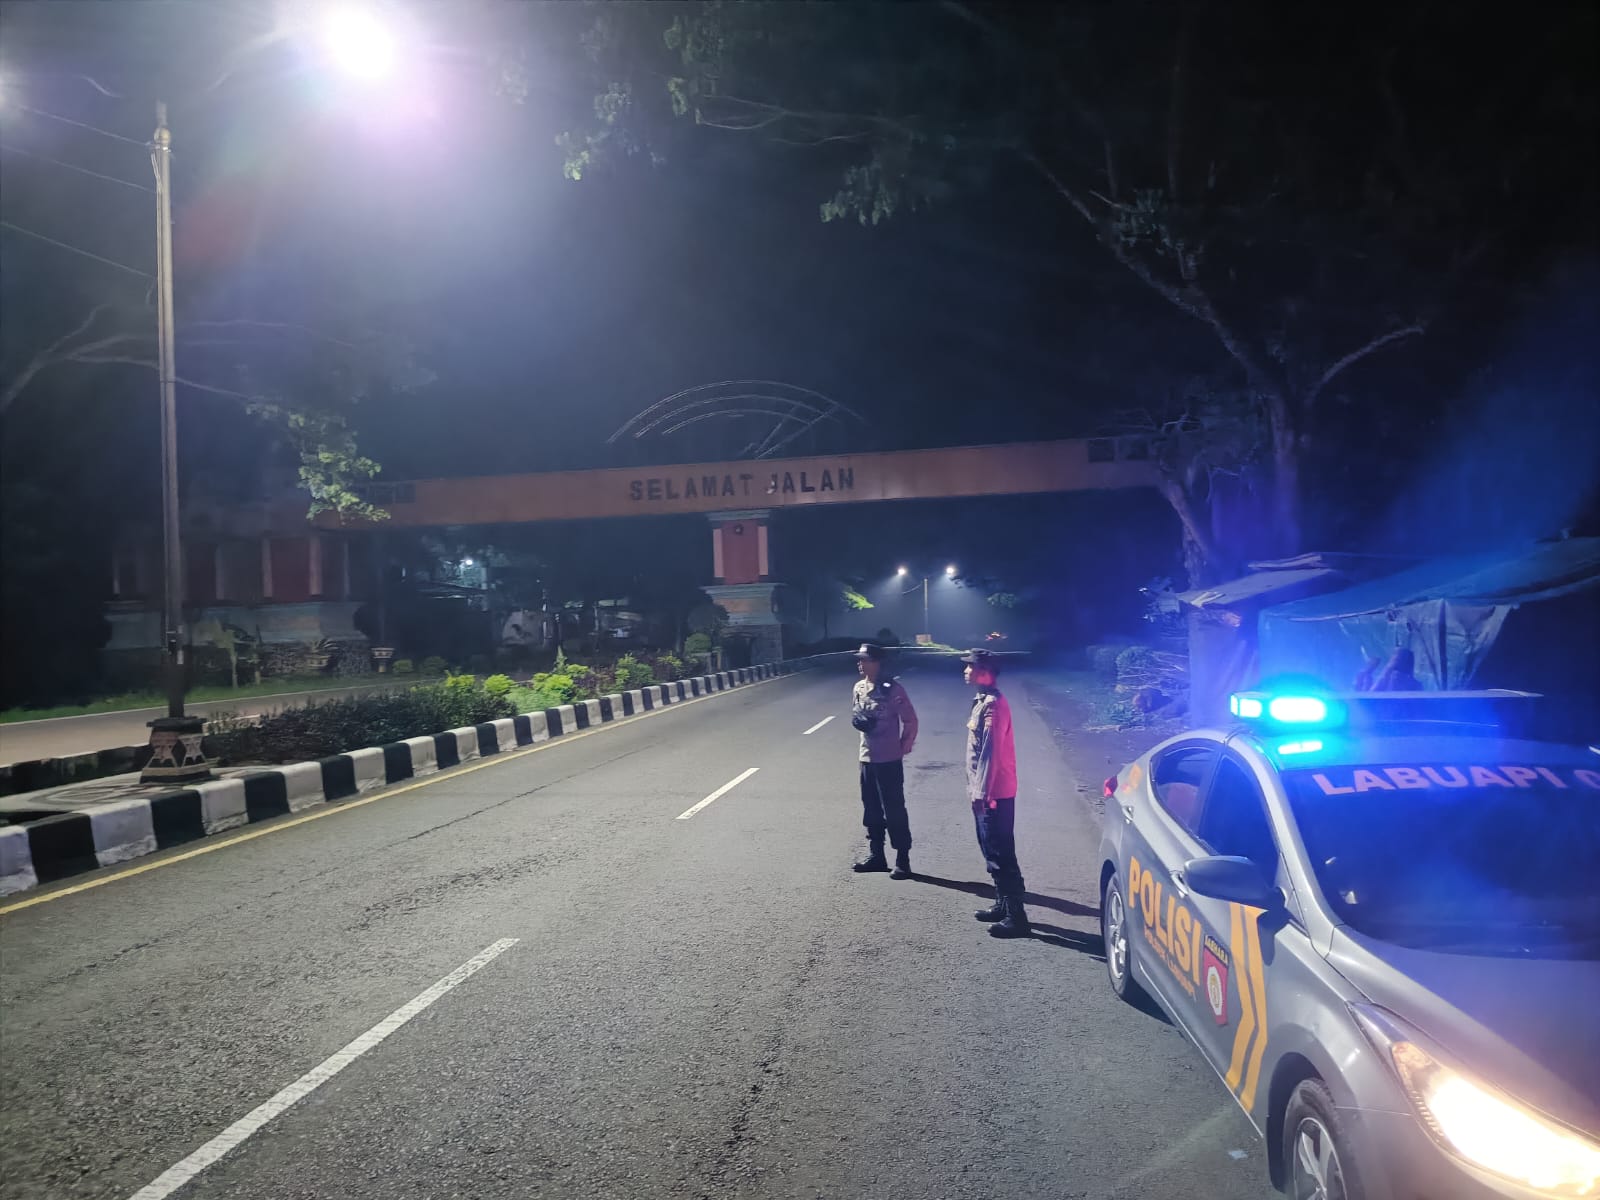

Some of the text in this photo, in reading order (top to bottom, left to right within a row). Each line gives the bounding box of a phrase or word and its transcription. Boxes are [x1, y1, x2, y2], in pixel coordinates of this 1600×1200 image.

[629, 467, 854, 501] SELAMAT JALAN
[1312, 766, 1568, 795] LABUAPI
[1128, 856, 1203, 986] POLISI
